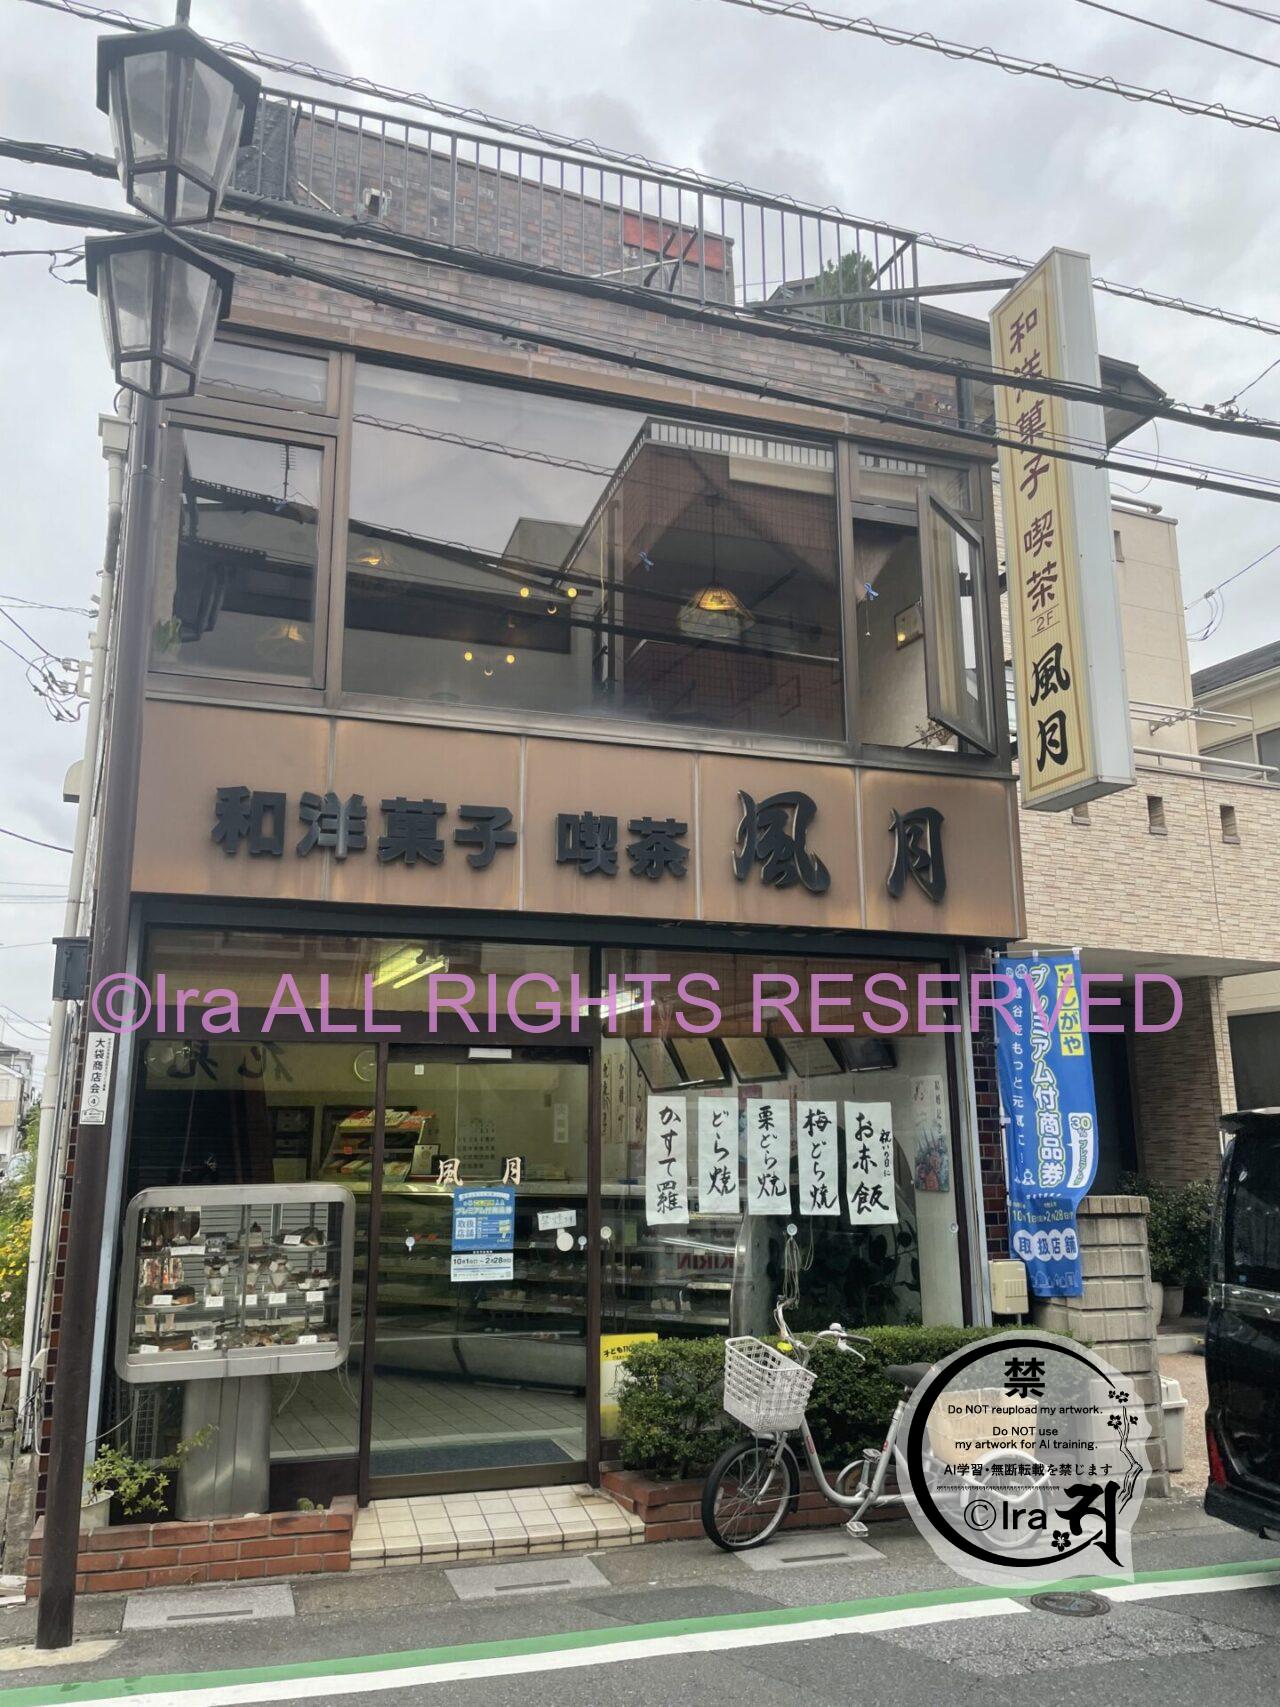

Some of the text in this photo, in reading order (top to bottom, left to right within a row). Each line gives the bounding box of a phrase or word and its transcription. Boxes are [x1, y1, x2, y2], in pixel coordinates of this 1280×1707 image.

[1024, 509, 1058, 612] 喫茶
[1036, 610, 1054, 633] 2F
[1030, 642, 1071, 772] 風月
[212, 786, 947, 906] 和洋菓子 喫茶 風月
[90, 1037, 106, 1093] 大袋商店会
[437, 1157, 522, 1186] 風月
[706, 1110, 736, 1197] どら焼
[757, 1105, 787, 1199] 栗どら焼
[803, 1108, 838, 1211] 梅どら焼
[852, 1112, 890, 1215] お赤飯
[1018, 1235, 1077, 1255] 取扱店舗
